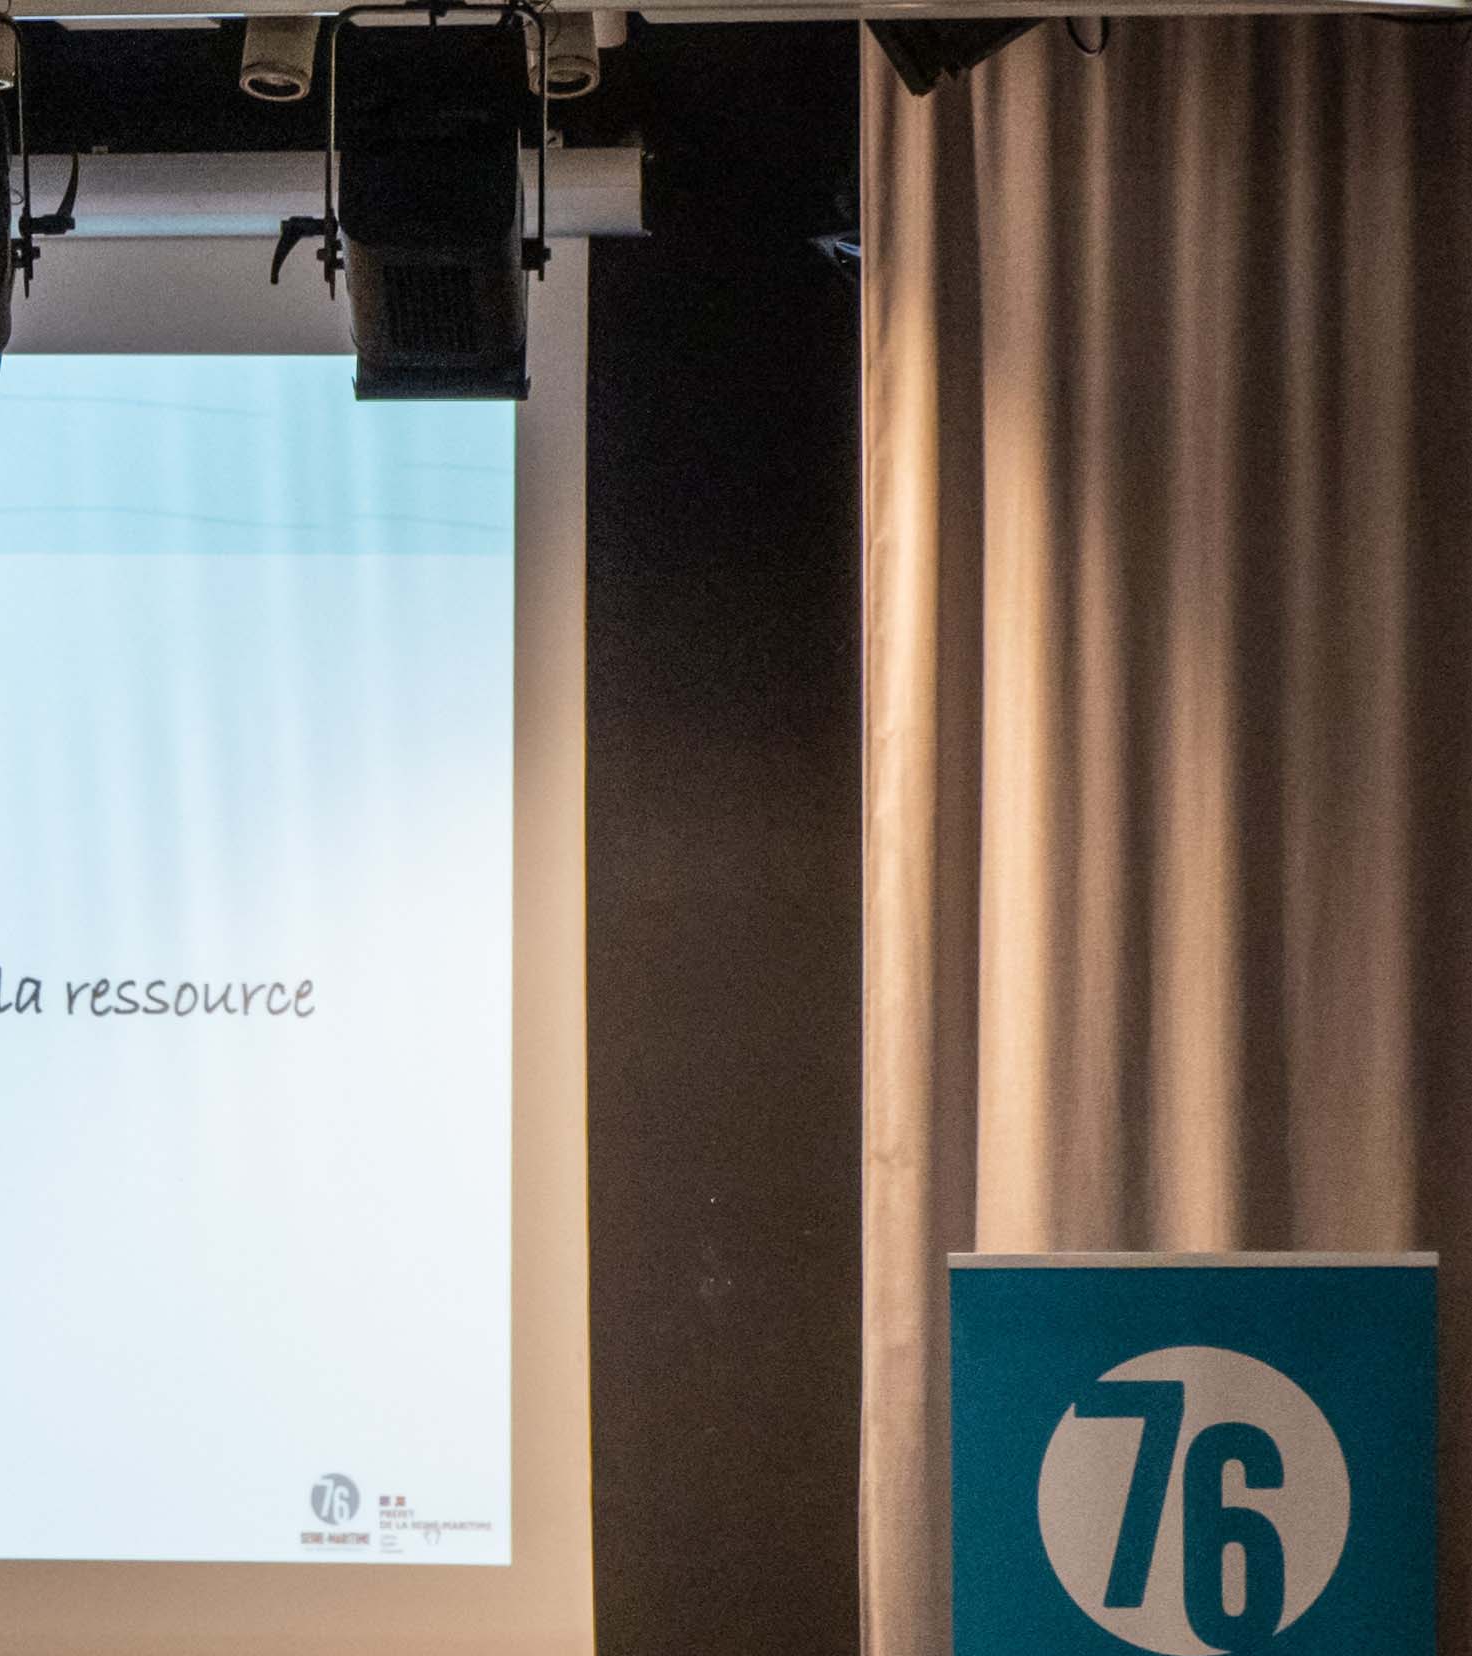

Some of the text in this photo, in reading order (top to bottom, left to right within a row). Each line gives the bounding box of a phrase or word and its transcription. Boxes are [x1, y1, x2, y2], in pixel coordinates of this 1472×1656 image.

[66, 978, 314, 1017] ressource
[313, 1478, 352, 1526] 76
[1073, 1380, 1286, 1651] 76
